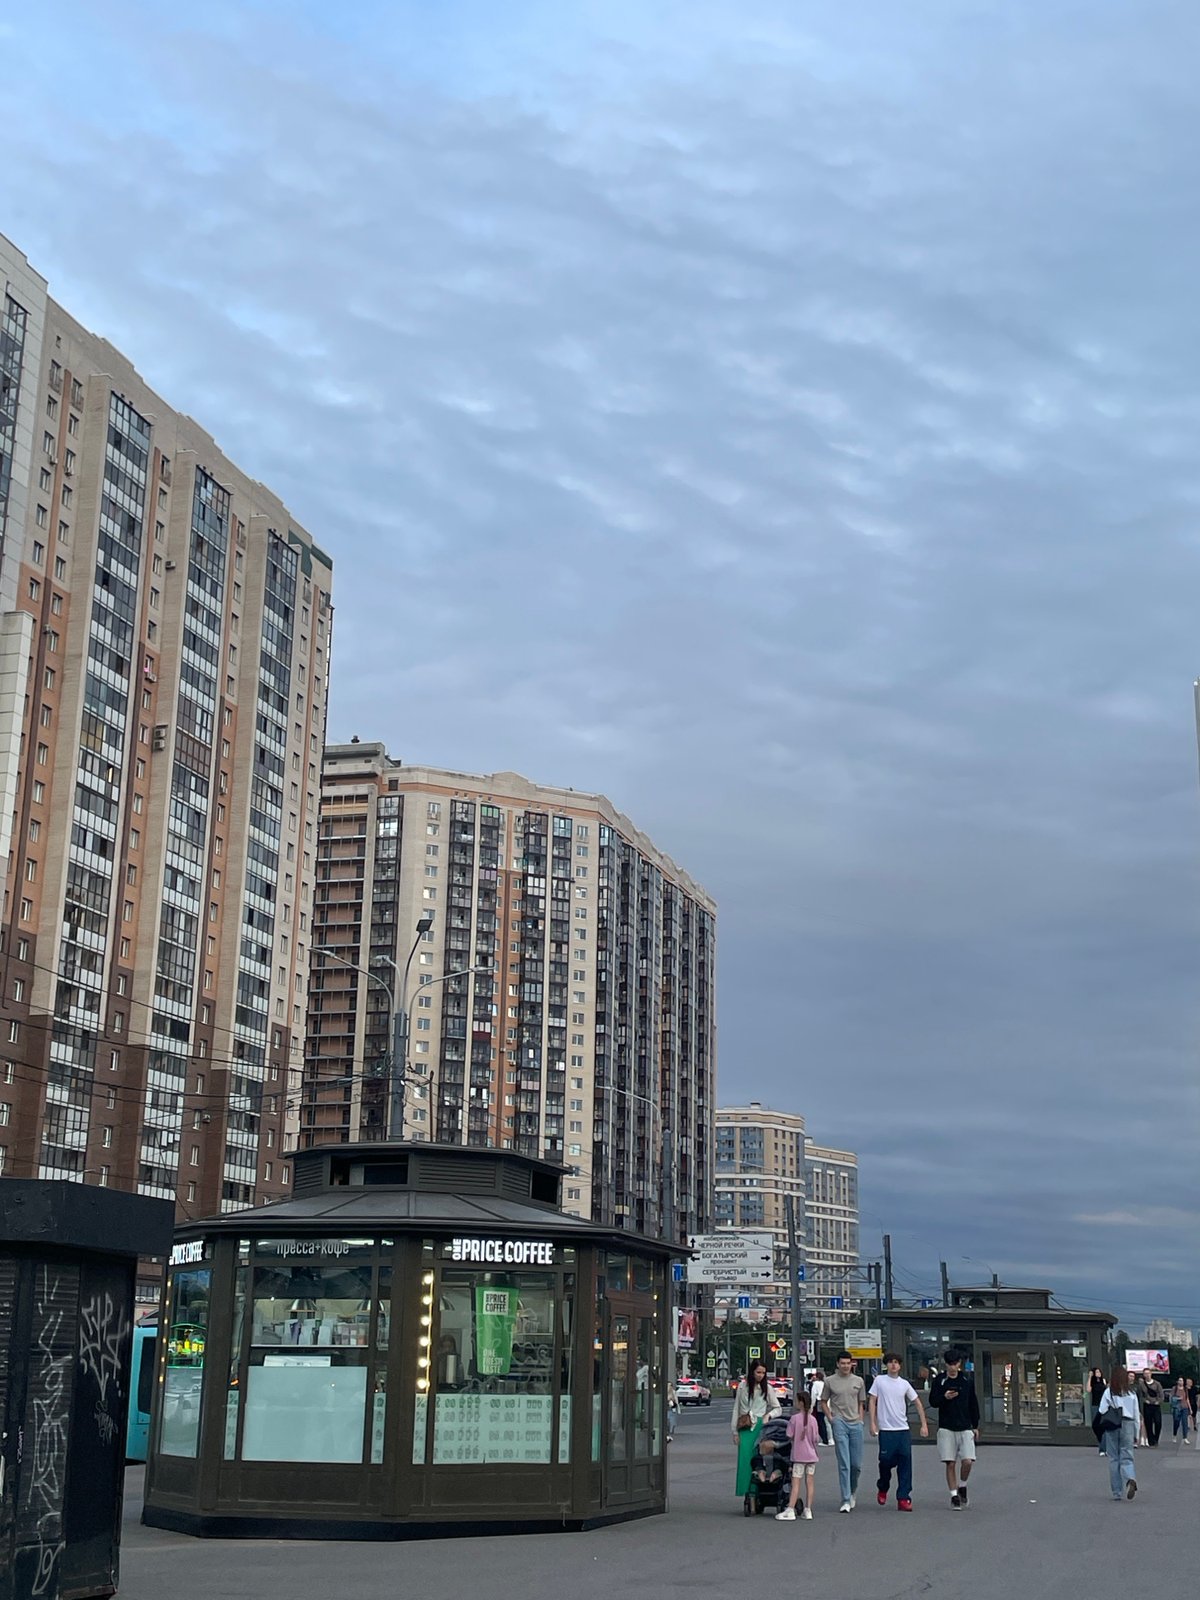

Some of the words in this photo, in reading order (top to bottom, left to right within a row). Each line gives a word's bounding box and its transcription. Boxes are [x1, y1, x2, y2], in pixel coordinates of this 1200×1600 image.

[452, 1238, 462, 1260] ONE
[461, 1239, 503, 1263] PRICE
[504, 1241, 554, 1265] COFFEE
[701, 1251, 748, 1259] БОГАТЫРСКИЙ
[702, 1268, 747, 1276] СЕРЕБРИСТЫЙ
[489, 1293, 507, 1303] PRICE
[485, 1303, 507, 1313] COFFEE
[482, 1365, 501, 1374] TASTE
